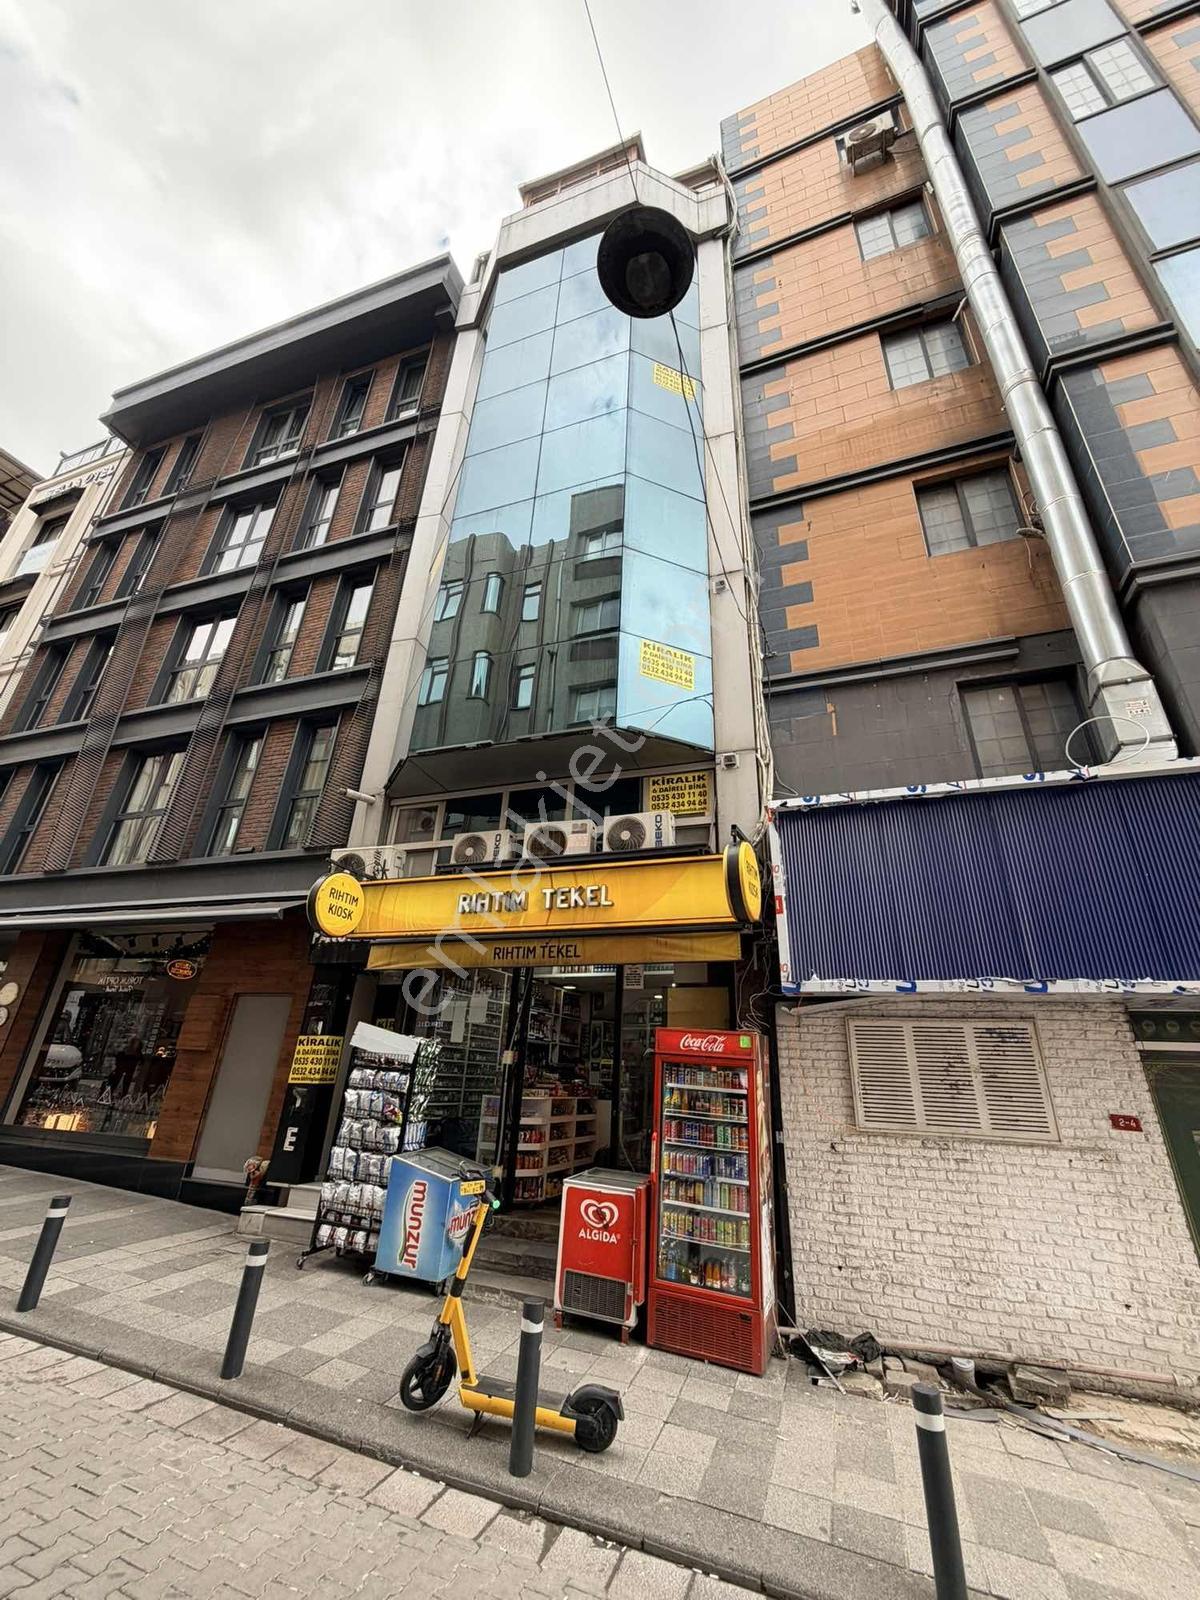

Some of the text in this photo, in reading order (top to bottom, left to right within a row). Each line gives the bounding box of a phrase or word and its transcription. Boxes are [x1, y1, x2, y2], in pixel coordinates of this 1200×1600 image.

[652, 774, 706, 786] KİRALIK
[659, 784, 687, 793] DAİRELİ
[651, 802, 670, 810] 0532
[329, 887, 359, 907] RIHTIM
[458, 885, 614, 914] RIHTIM TEKEL
[328, 903, 354, 921] KIOSK
[493, 943, 581, 960] RIHTIM TEKEL
[298, 1037, 342, 1047] KİRALIK
[294, 1057, 309, 1065] 0535
[310, 1057, 323, 1065] 430
[292, 1067, 307, 1075] 0532
[308, 1067, 321, 1075] 434
[1119, 1118, 1136, 1127] 2-4
[404, 1181, 428, 1269] munzur
